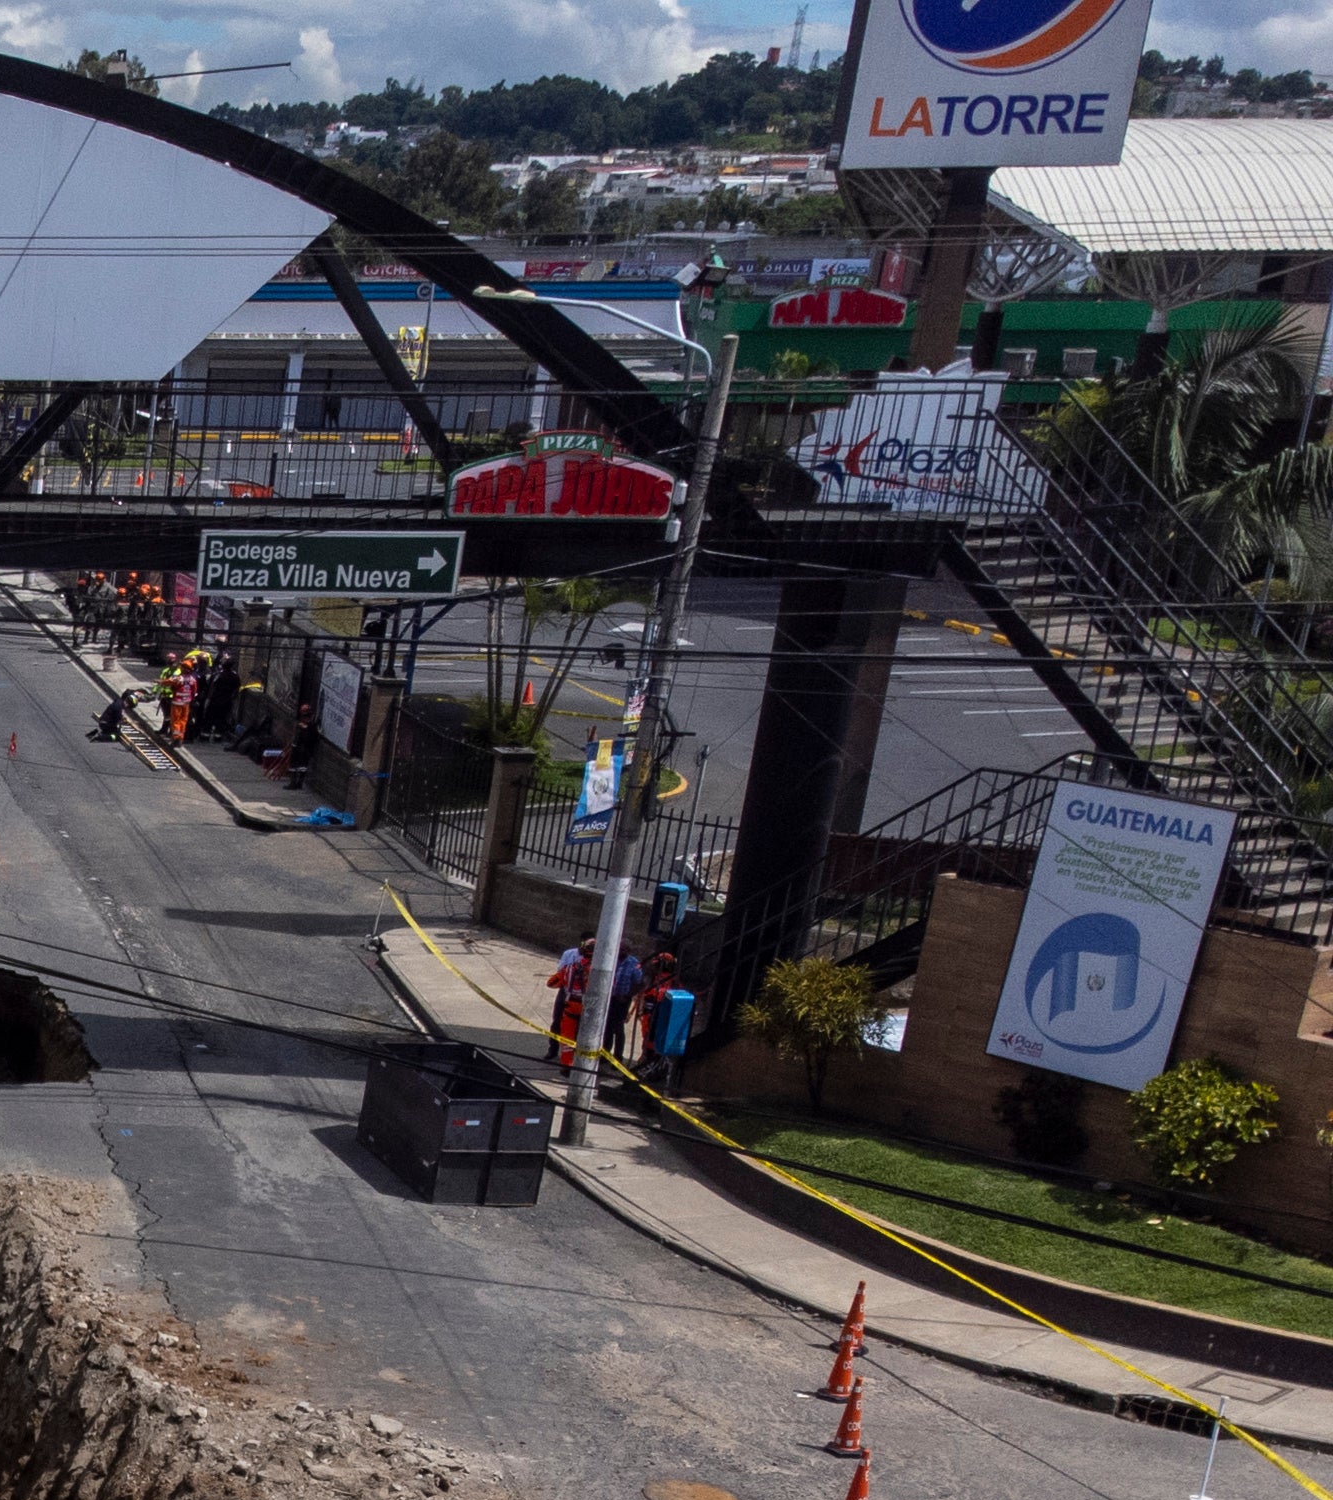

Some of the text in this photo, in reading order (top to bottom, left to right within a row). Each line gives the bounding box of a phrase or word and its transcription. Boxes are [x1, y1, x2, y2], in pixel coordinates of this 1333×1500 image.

[737, 263, 810, 274] AUOHAUS
[543, 434, 599, 450] PIZZA
[874, 438, 980, 474] Plaza
[453, 461, 547, 515] PAPA
[209, 540, 298, 564] Bodegas
[206, 563, 412, 589] Plaza Villa Nueva
[1066, 799, 1215, 846] GUATEMALA
